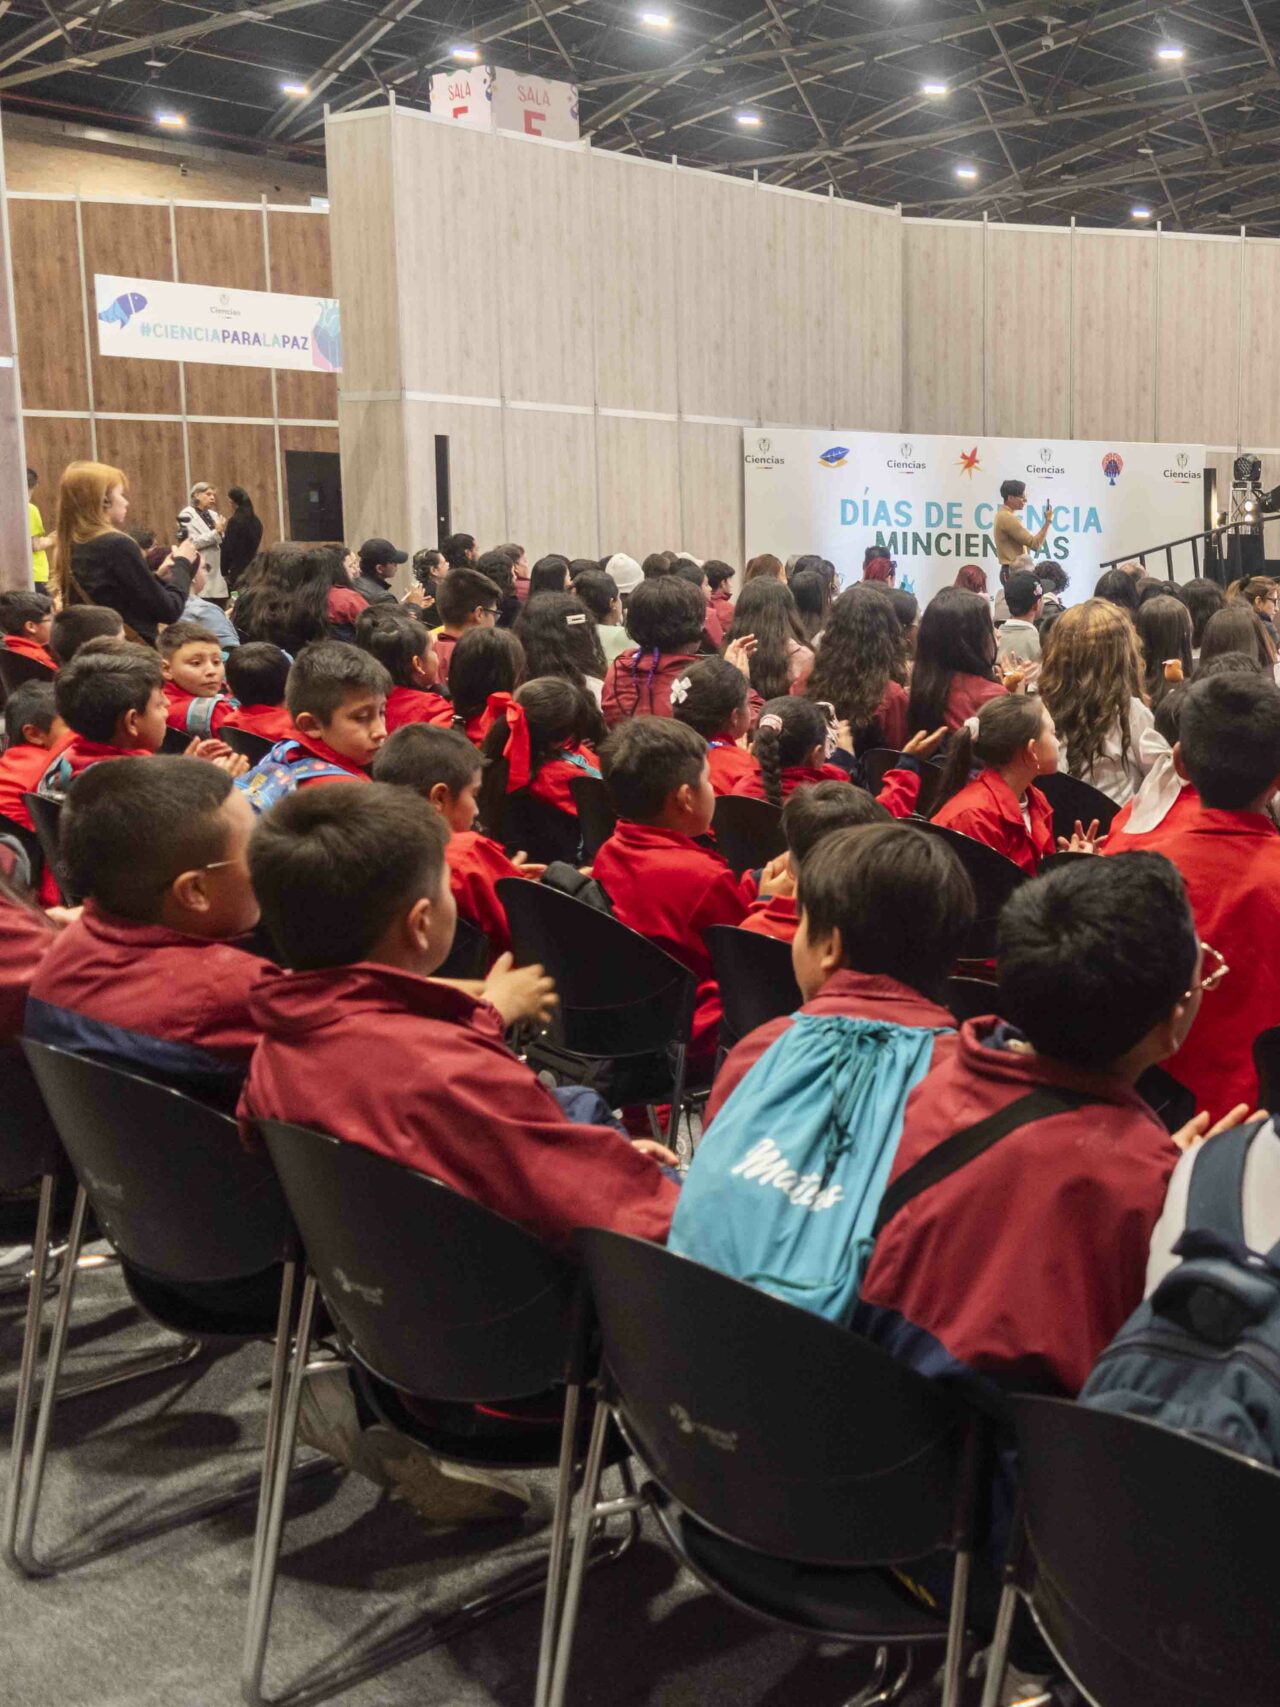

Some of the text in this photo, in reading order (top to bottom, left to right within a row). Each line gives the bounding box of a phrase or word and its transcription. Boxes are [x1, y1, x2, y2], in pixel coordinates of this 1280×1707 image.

[448, 80, 472, 101] SALA
[517, 84, 551, 107] SALA
[139, 321, 310, 351] #CIENCIAPARALAPAZ
[744, 454, 785, 466] Ciencias
[886, 459, 927, 470] Ciencias
[1026, 464, 1065, 475] Ciencias
[1163, 469, 1202, 480] Ciencias
[840, 486, 913, 528] DÍAS
[925, 501, 963, 529] DE
